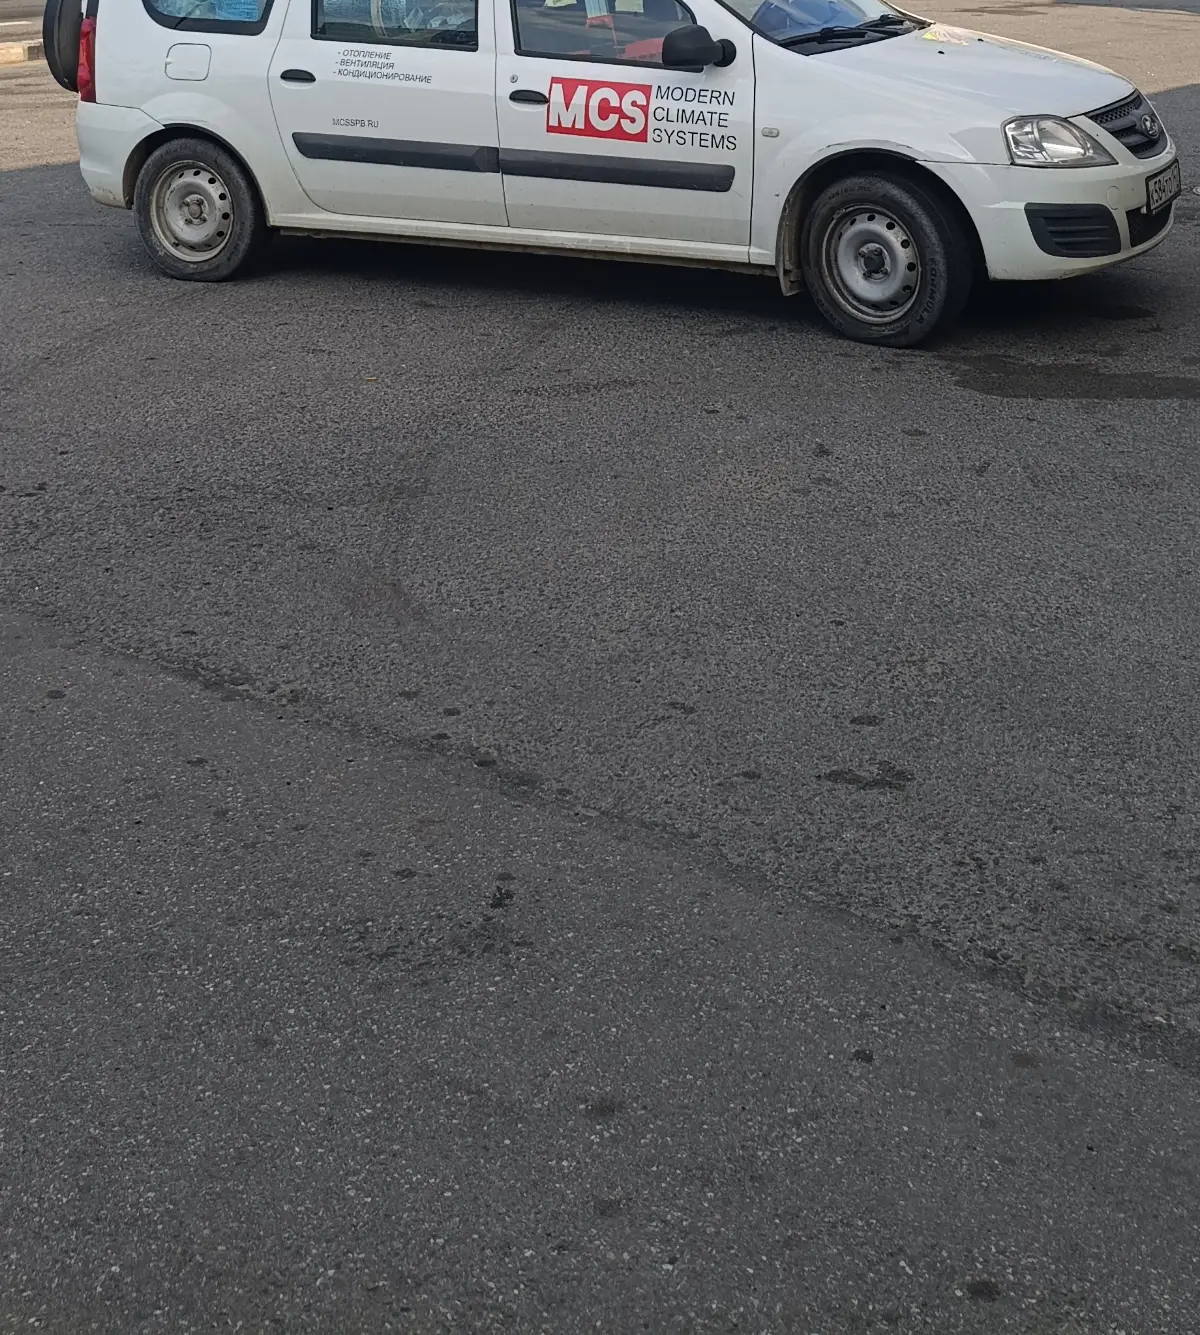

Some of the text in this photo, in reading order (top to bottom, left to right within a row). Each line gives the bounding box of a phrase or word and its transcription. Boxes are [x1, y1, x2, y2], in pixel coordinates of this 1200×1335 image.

[339, 59, 395, 70] ВЕНТИЛЯЦИЯ
[342, 49, 392, 60] ОТОПЛЕНИЕ
[337, 69, 432, 84] КОНДИЦИОНИРОВАНИЕ
[655, 85, 736, 107] MODERN
[548, 83, 648, 136] MCS
[652, 107, 729, 129] CLIMATE
[652, 128, 737, 152] SYSTEMS
